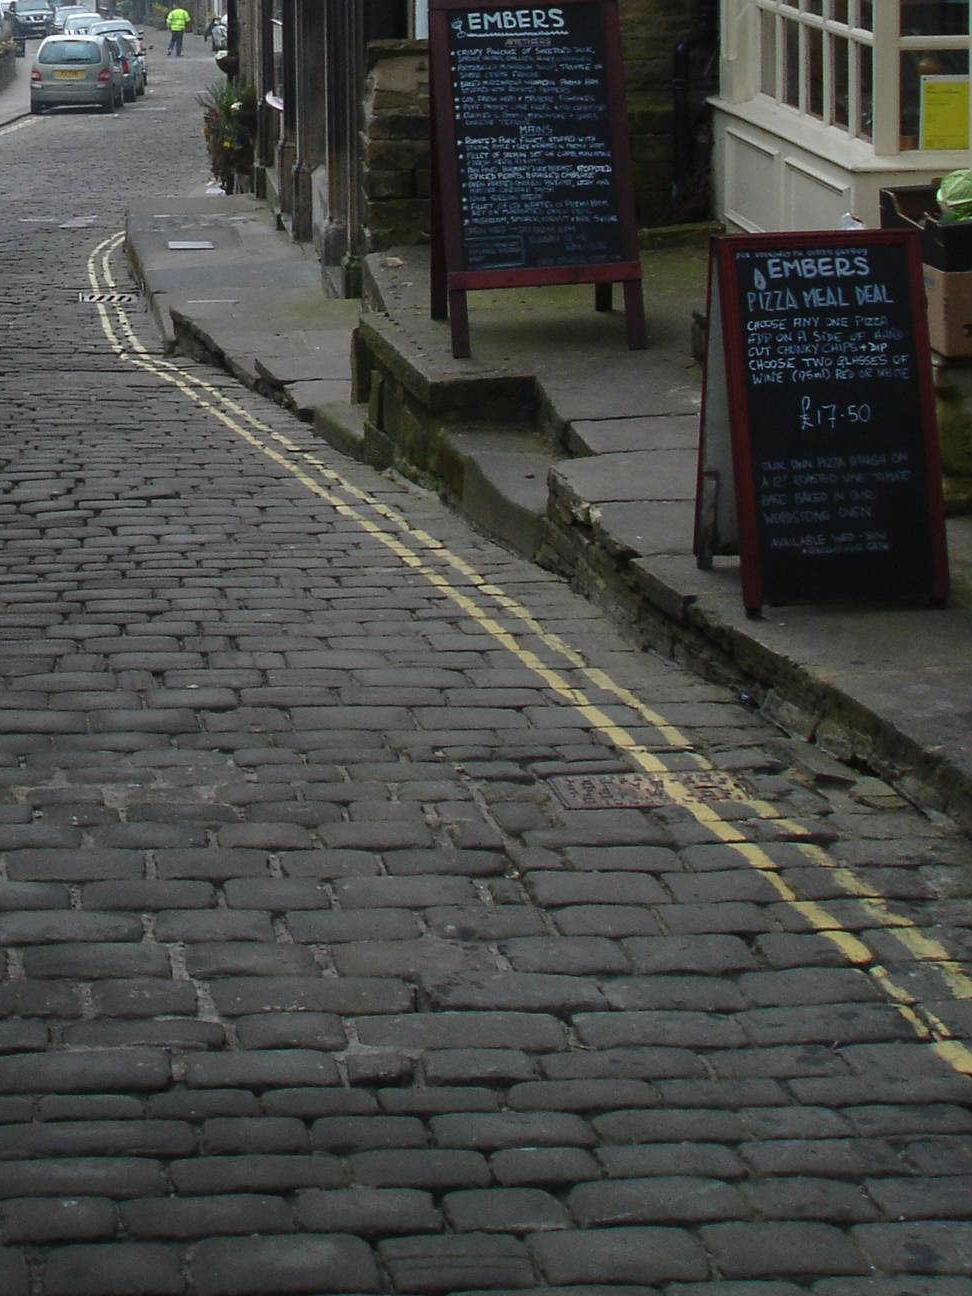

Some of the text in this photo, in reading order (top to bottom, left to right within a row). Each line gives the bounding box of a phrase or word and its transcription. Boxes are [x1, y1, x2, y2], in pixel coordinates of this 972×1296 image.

[467, 8, 566, 30] EMBERS
[456, 48, 484, 56] CRISPY
[521, 47, 533, 55] OF
[584, 77, 599, 86] HAM
[519, 125, 553, 135] MAINS
[464, 136, 497, 144] ROASTED
[466, 151, 489, 160] FILLET
[468, 172, 497, 181] SPICED
[576, 164, 612, 173] ROASTED
[767, 256, 871, 279] EMBERS
[747, 283, 895, 312] PIZZA MEAL DEAL
[747, 315, 889, 331] CHOOSE ANY ONE PIZZA
[748, 332, 772, 345] ADD
[775, 331, 793, 342] ON
[797, 329, 807, 343] A
[850, 331, 866, 342] OF
[747, 346, 772, 357] CUT
[777, 343, 819, 355] CHUNKY
[748, 354, 910, 371] CHOOSE TWO GLASSES OF
[752, 371, 783, 385] WINE
[834, 368, 855, 380] RED
[858, 368, 873, 378] OR
[876, 367, 911, 380] WHITE
[817, 456, 846, 469] PIZZA
[891, 451, 908, 464] ON
[794, 490, 828, 505] BAKED
[833, 490, 845, 502] IN
[850, 489, 876, 501] OUR
[838, 506, 872, 519] OVEN
[771, 533, 826, 548] AVAILABLE
[831, 532, 855, 543] WED
